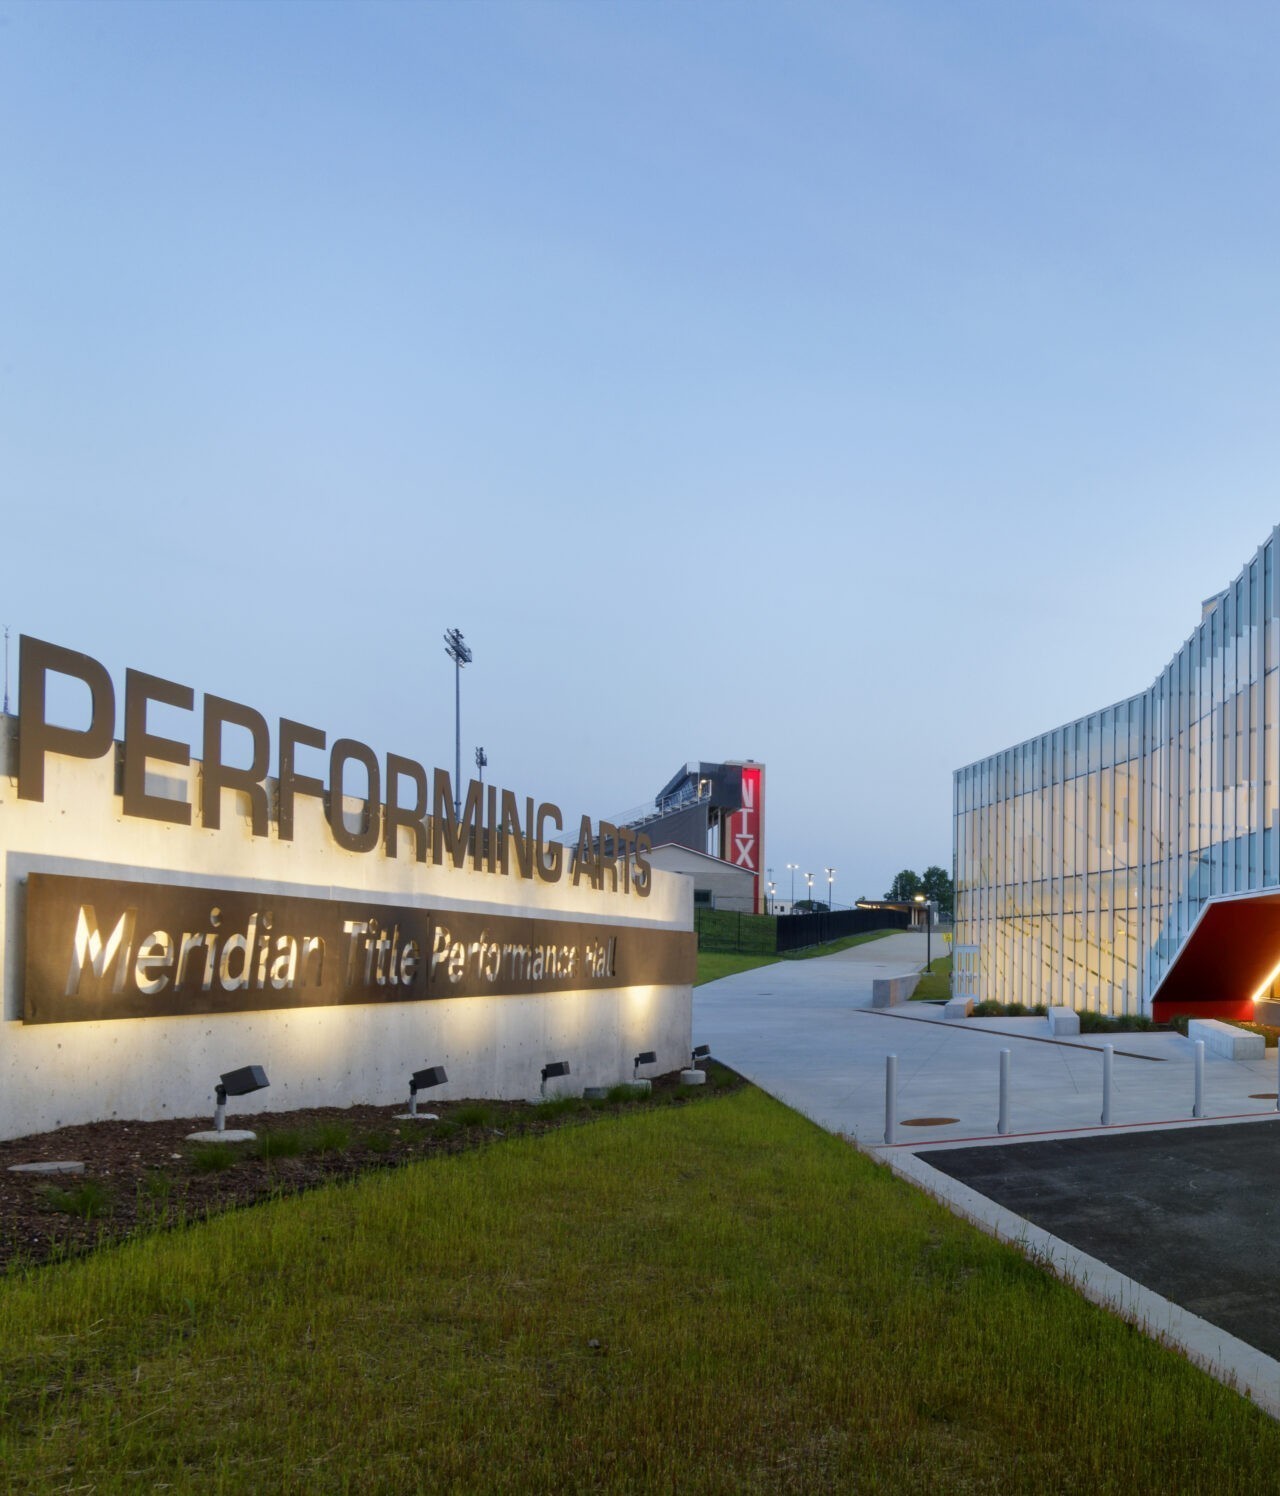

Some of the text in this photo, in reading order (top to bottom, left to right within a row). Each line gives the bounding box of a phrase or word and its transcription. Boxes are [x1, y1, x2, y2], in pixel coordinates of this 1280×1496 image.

[17, 633, 651, 897] PERFORMING ARTS
[65, 904, 617, 995] Meridian Title Performance Hall
